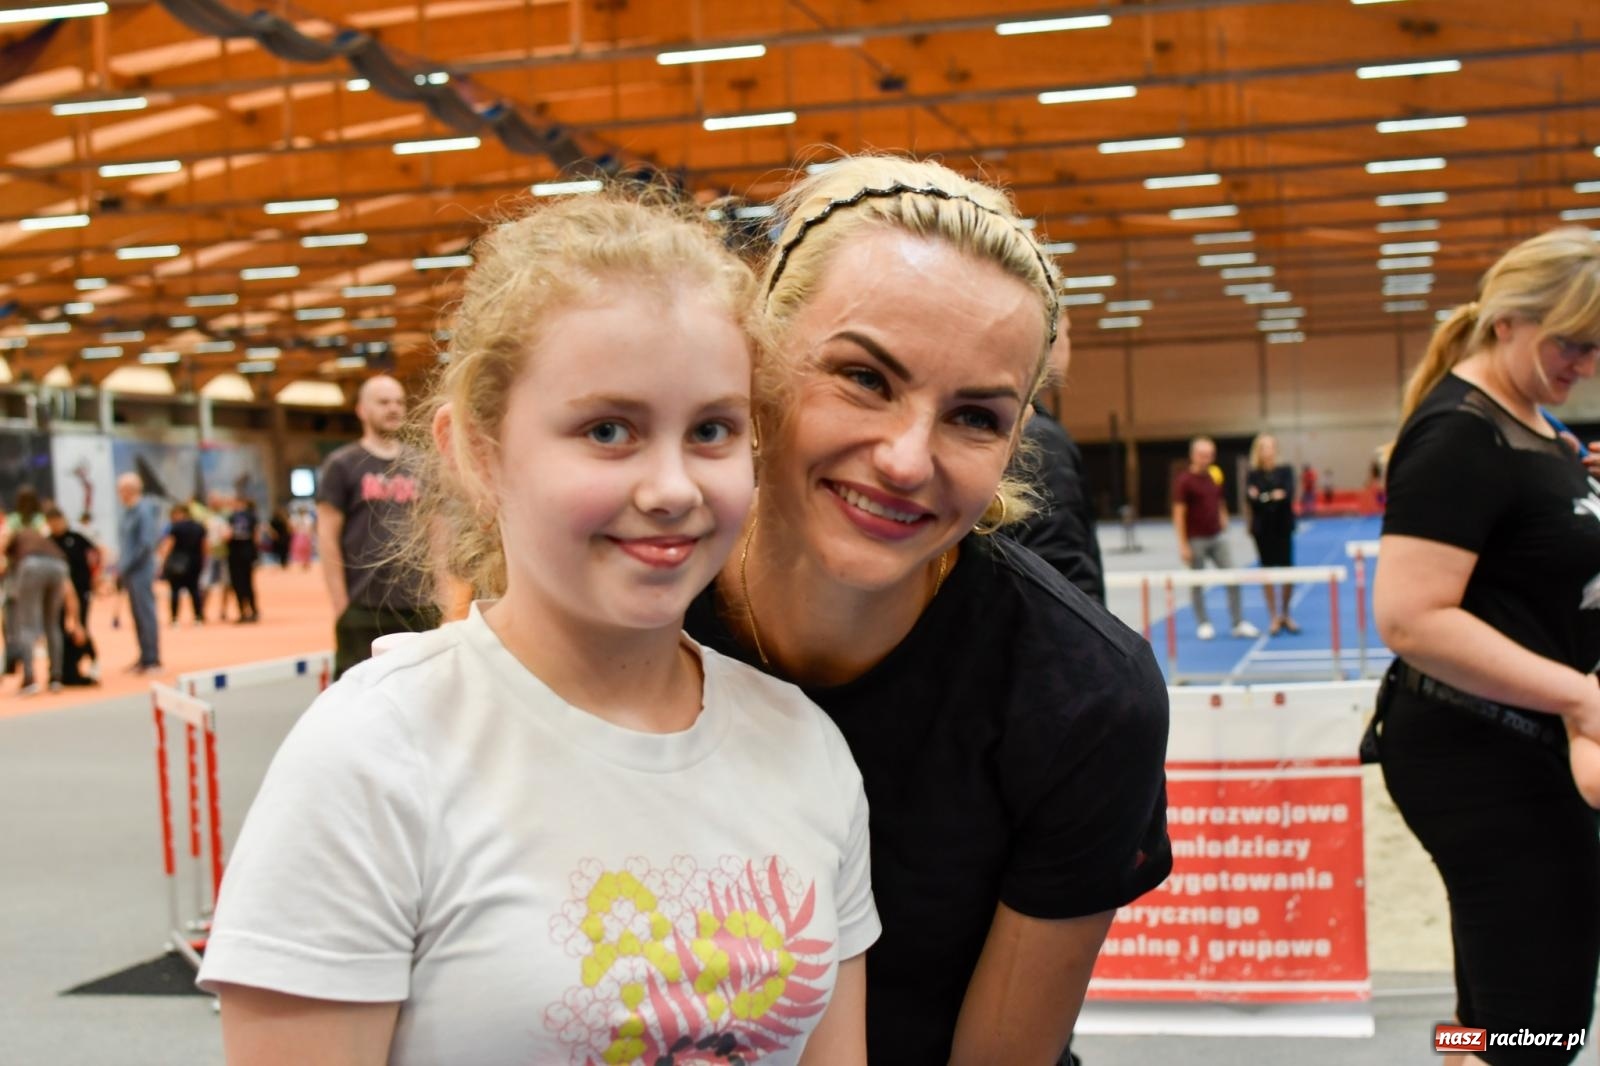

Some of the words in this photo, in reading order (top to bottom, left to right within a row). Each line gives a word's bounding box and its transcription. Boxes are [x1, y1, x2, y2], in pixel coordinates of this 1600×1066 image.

[1113, 905, 1259, 928] orycznego
[1100, 934, 1181, 956] ualne
[1208, 938, 1331, 962] grupowe
